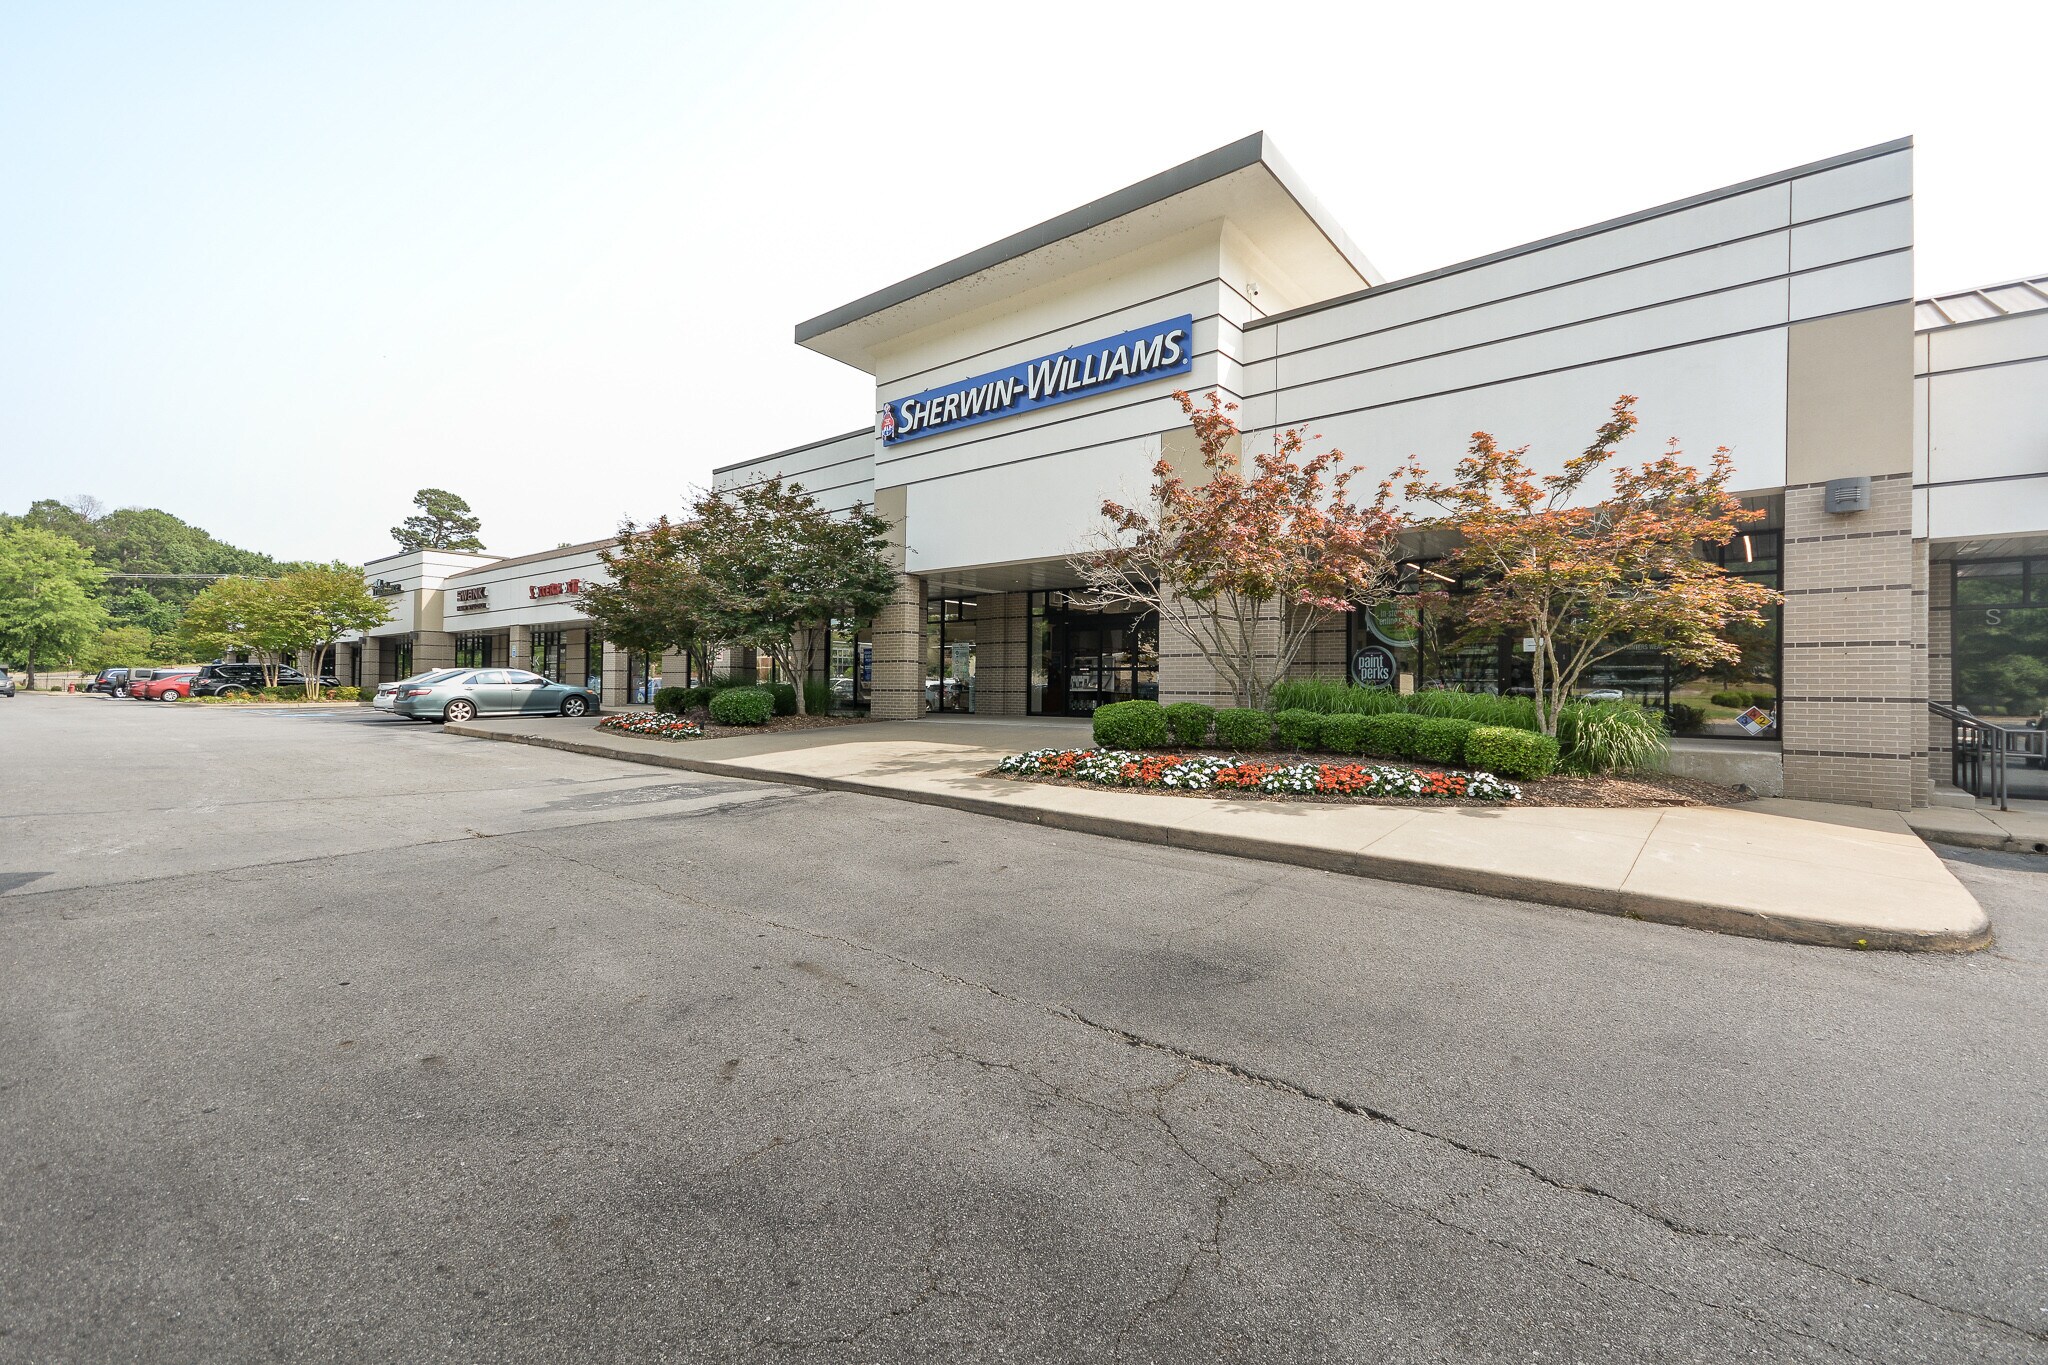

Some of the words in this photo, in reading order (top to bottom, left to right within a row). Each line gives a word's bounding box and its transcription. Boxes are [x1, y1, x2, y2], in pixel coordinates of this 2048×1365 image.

[898, 329, 1184, 435] SHERWIN-WILLIAMS
[1358, 654, 1384, 670] paint
[1361, 664, 1389, 681] perks
[1741, 716, 1748, 725] 3
[1759, 716, 1766, 725] 2
